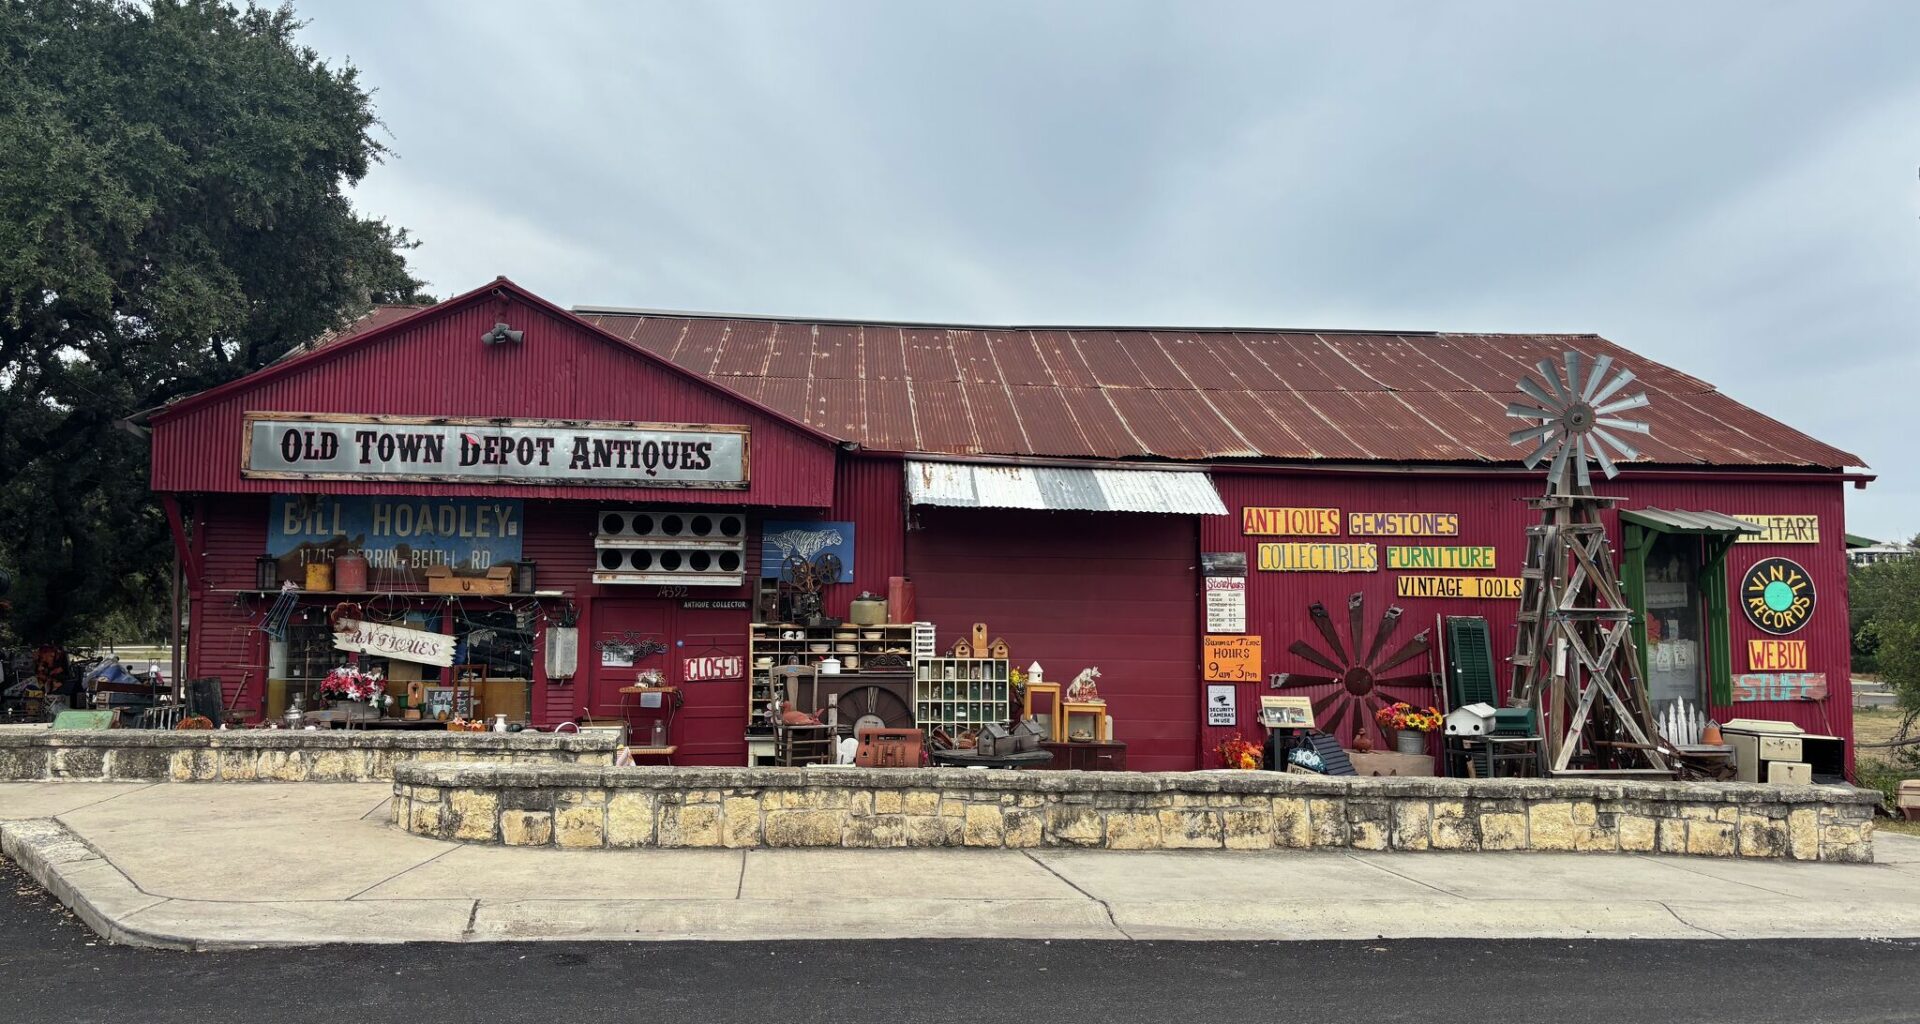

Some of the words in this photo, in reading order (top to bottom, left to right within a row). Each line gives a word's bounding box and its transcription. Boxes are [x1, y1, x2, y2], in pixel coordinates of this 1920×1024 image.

[280, 428, 339, 463] OLD
[356, 431, 445, 464] TOWN
[459, 433, 554, 466] DEPOT
[569, 436, 712, 477] ANTIQUES
[283, 502, 346, 536] BILL
[1244, 509, 1339, 534] ANTIQUES
[1350, 513, 1457, 534] GEMSTONES
[1736, 517, 1816, 540] LITARY
[471, 549, 491, 570] RD
[1260, 544, 1377, 569] COLLECTIBLES
[1388, 547, 1493, 567] FURNITURE
[1399, 577, 1463, 597] VINTAGE
[1475, 578, 1521, 597] TOOLS
[1748, 565, 1807, 596] VINYL
[1748, 596, 1810, 628] RECORDS
[349, 629, 440, 656] ANTIQUES
[1214, 648, 1250, 659] HOURS
[688, 657, 739, 681] CLOSED
[1740, 673, 1815, 701] STUFF
